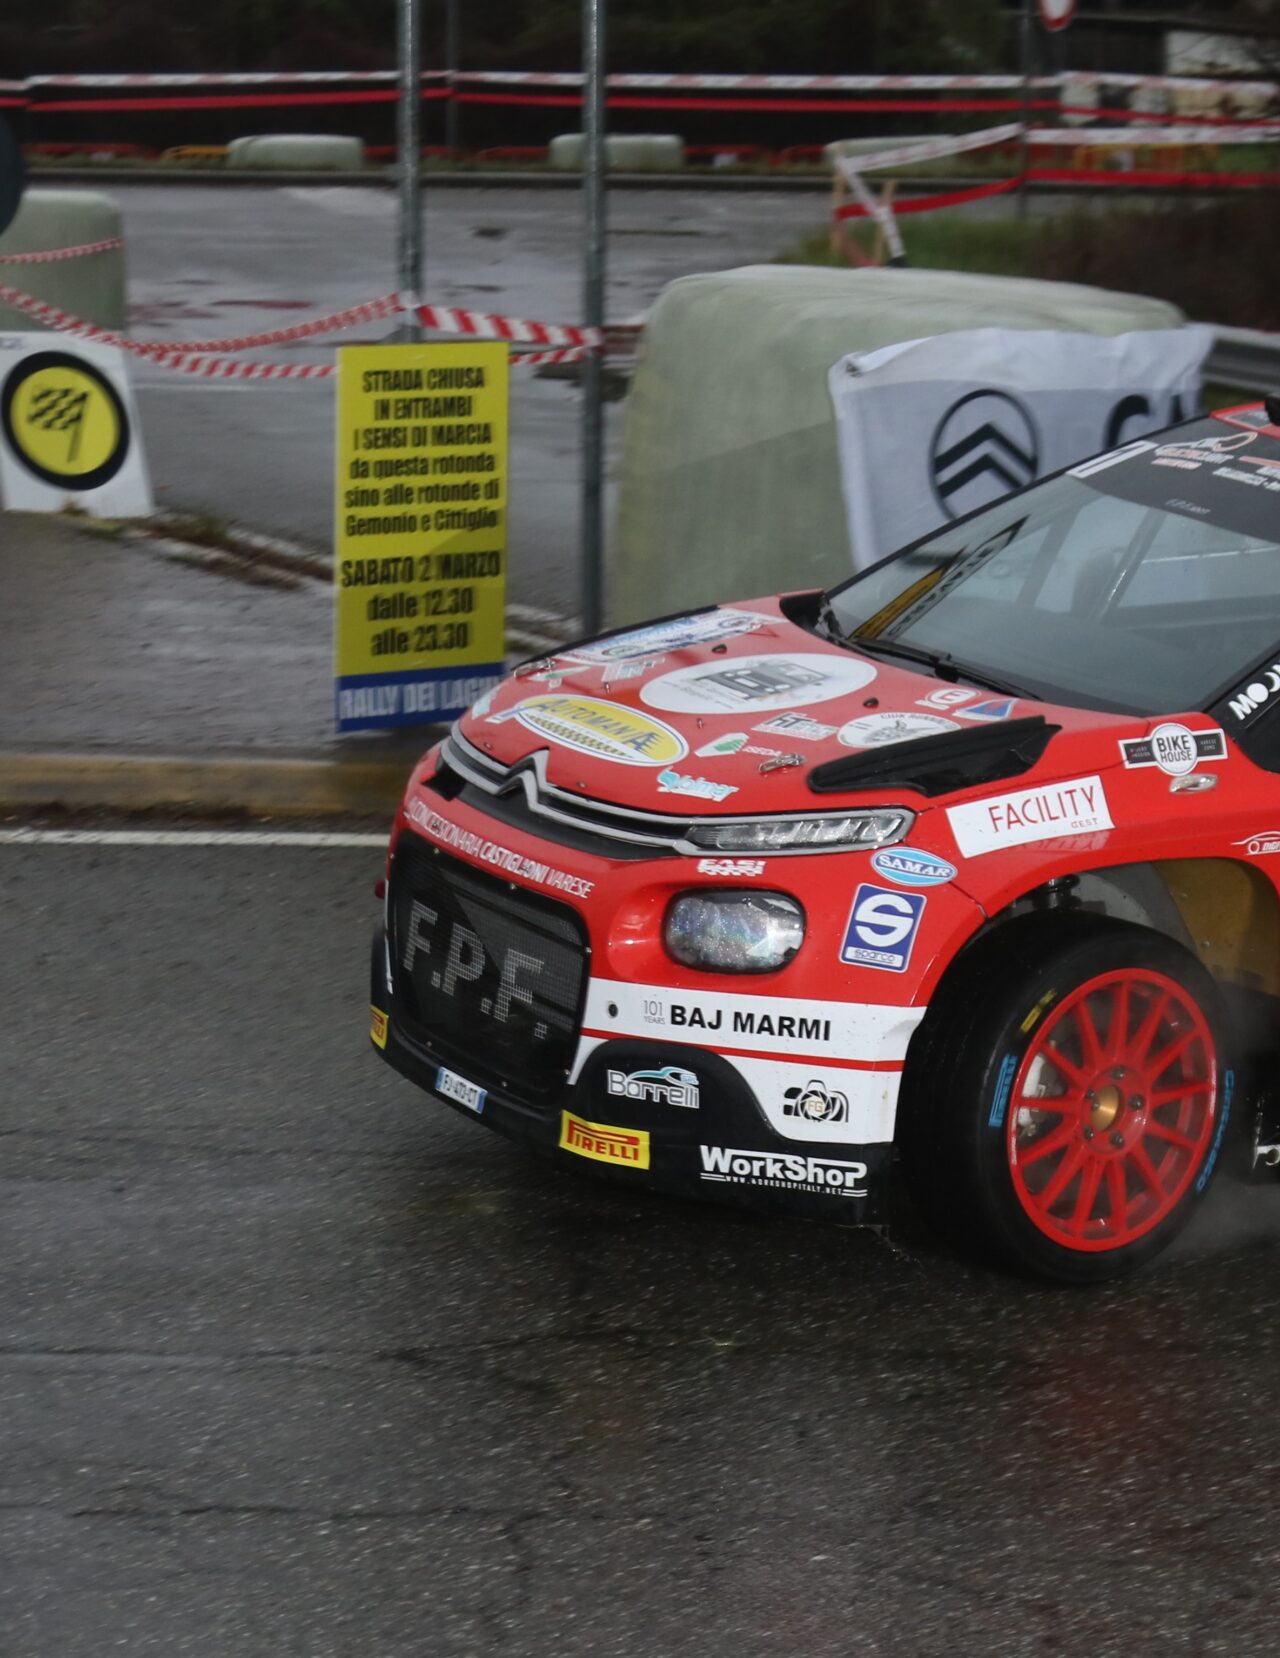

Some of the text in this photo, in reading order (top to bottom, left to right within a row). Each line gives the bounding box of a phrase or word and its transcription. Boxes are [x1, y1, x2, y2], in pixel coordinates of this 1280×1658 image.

[362, 366, 485, 393] STRADA CHIUSA
[374, 396, 472, 421] IN ENTRAMBI
[362, 426, 407, 449] SENSI
[411, 425, 428, 447] DI
[431, 422, 492, 446] MARCIA
[350, 452, 495, 480] da questa rotonda
[345, 478, 500, 508] sino alle rotonde di
[345, 507, 499, 537] Gemonio e Cittiglio
[341, 551, 501, 588] SABATO 2 MARZO
[367, 586, 474, 621] dalle 12.30
[370, 621, 470, 656] alle 23.30
[339, 685, 399, 720] RALLY
[403, 681, 436, 714] DEI
[1156, 734, 1191, 753] BIKE
[1160, 750, 1193, 764] HOUSE
[988, 785, 1096, 833] FACILITY
[477, 840, 546, 882] CASTIGLIONI
[547, 867, 595, 899] VARESE
[878, 855, 951, 878] SAMAR
[853, 949, 896, 961] sparco
[643, 1000, 663, 1016] 101
[644, 1015, 666, 1025] YEARS
[670, 1005, 831, 1041] BAJ MARMI
[567, 1119, 640, 1161] PIRELLI
